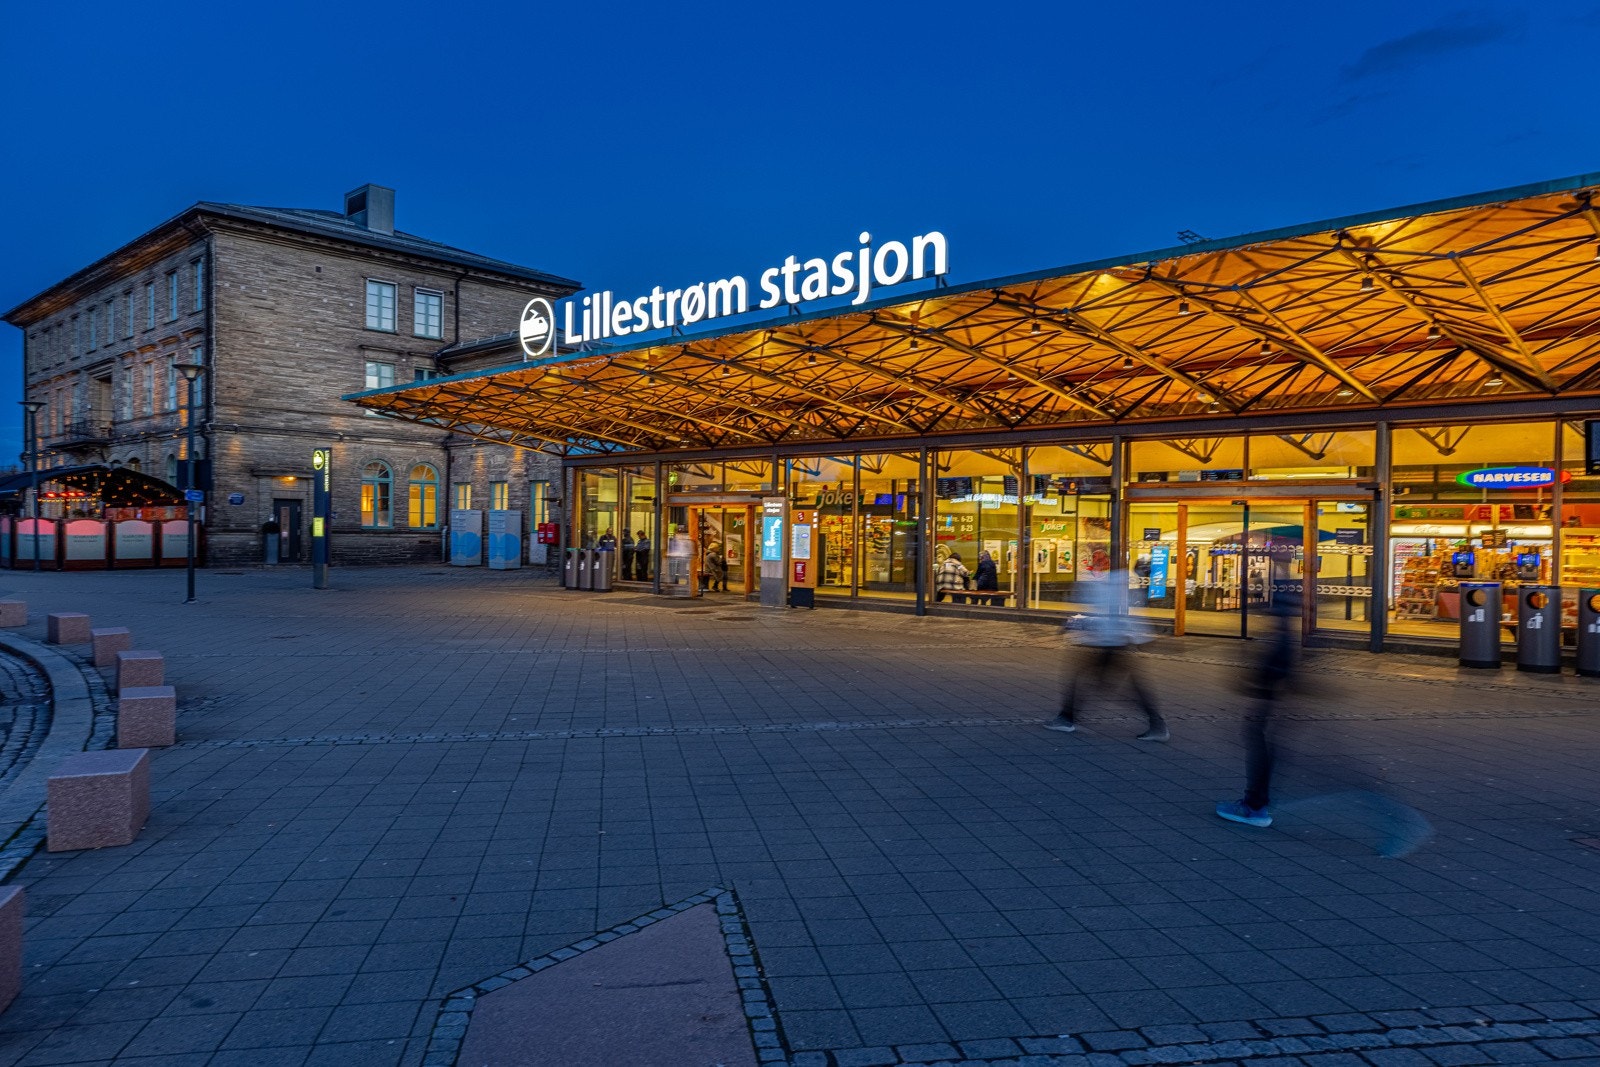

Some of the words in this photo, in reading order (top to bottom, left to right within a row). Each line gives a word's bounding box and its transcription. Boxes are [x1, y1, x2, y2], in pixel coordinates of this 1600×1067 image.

[564, 274, 749, 344] Lillestrøm
[760, 231, 948, 305] stasjon
[1473, 472, 1552, 483] NARVESEN
[816, 484, 853, 509] joke
[1040, 518, 1066, 532] joker
